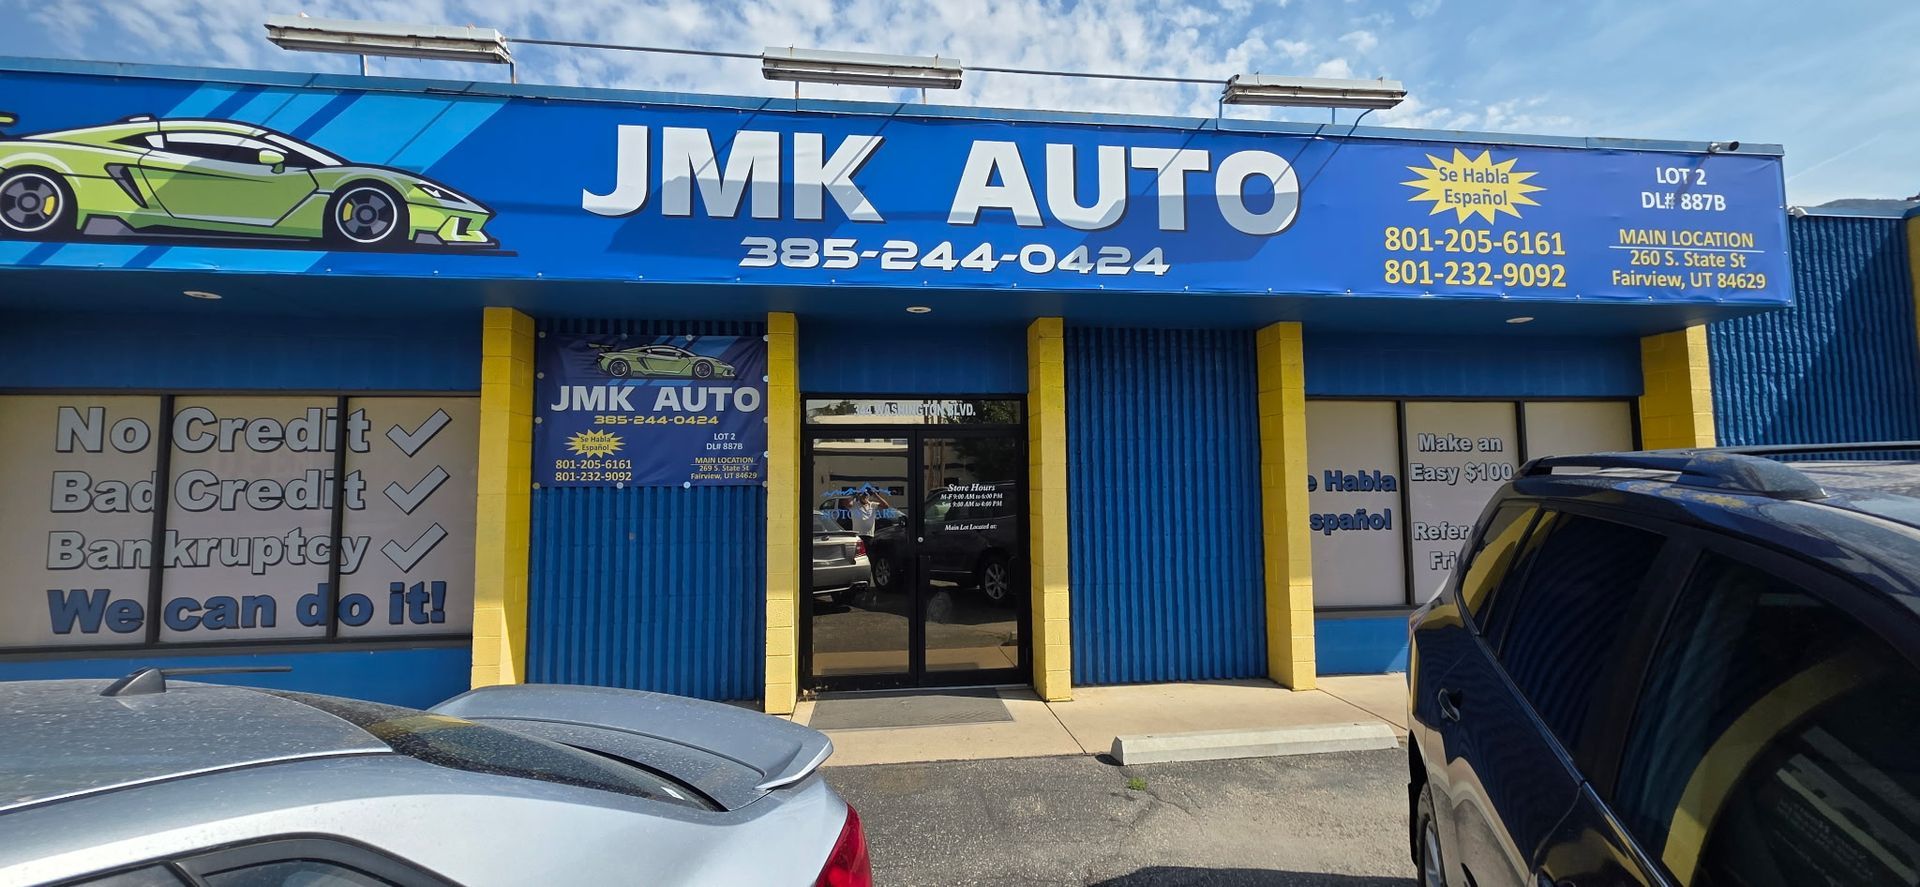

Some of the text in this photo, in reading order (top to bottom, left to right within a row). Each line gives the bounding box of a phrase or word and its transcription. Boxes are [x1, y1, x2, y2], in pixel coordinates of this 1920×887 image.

[582, 124, 1301, 236] JMK AUTO
[1438, 166, 1510, 184] Se Habla
[1656, 167, 1707, 186] LOT 2
[1444, 188, 1508, 207] Español
[1641, 191, 1727, 211] DL# 887B
[1384, 226, 1566, 256] 801-205-6161
[1619, 229, 1754, 248] MAIN LOCATION
[738, 235, 1171, 277] 385-244-0424
[1630, 250, 1747, 269] 260 S. State St
[1384, 259, 1567, 288] 801-232-9092
[1611, 270, 1767, 290] Fairview, UT 84629
[550, 385, 761, 413] JMK AUTO
[946, 403, 976, 416] BLVD.
[55, 406, 371, 453] No Credit
[593, 415, 719, 426] 385-244-0424
[713, 433, 736, 441] LOT 2
[1417, 433, 1503, 453] Make an
[555, 459, 632, 470] 801-205-6161
[1410, 462, 1514, 486] Easy $100
[555, 471, 632, 481] 801-232-9092
[1324, 470, 1397, 492] Habla
[50, 469, 367, 513] Bad Credit
[947, 483, 996, 492] Store Hours
[1309, 508, 1392, 535] spañol
[1413, 521, 1469, 540] Refer
[46, 528, 371, 575] Bankruptcy
[1430, 551, 1457, 570] Fri
[47, 581, 447, 634] We can do it!
